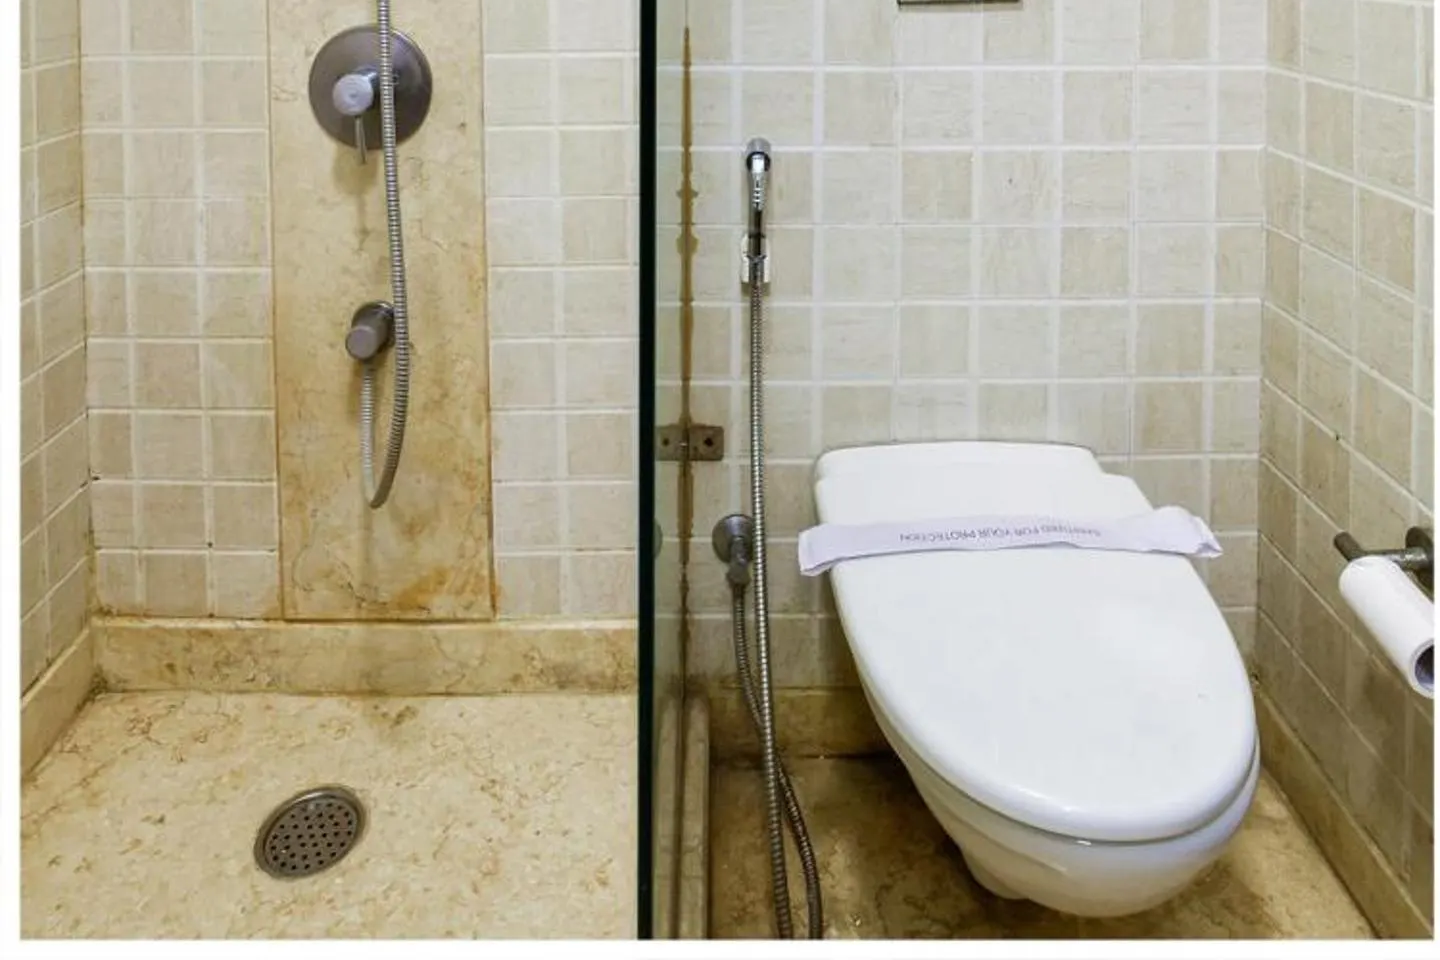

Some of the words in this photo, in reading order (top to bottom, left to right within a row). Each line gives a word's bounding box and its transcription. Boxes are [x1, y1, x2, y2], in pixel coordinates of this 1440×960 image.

[899, 528, 977, 542] PROTECTION
[978, 526, 1010, 538] YOUR
[1014, 525, 1039, 536] FOR
